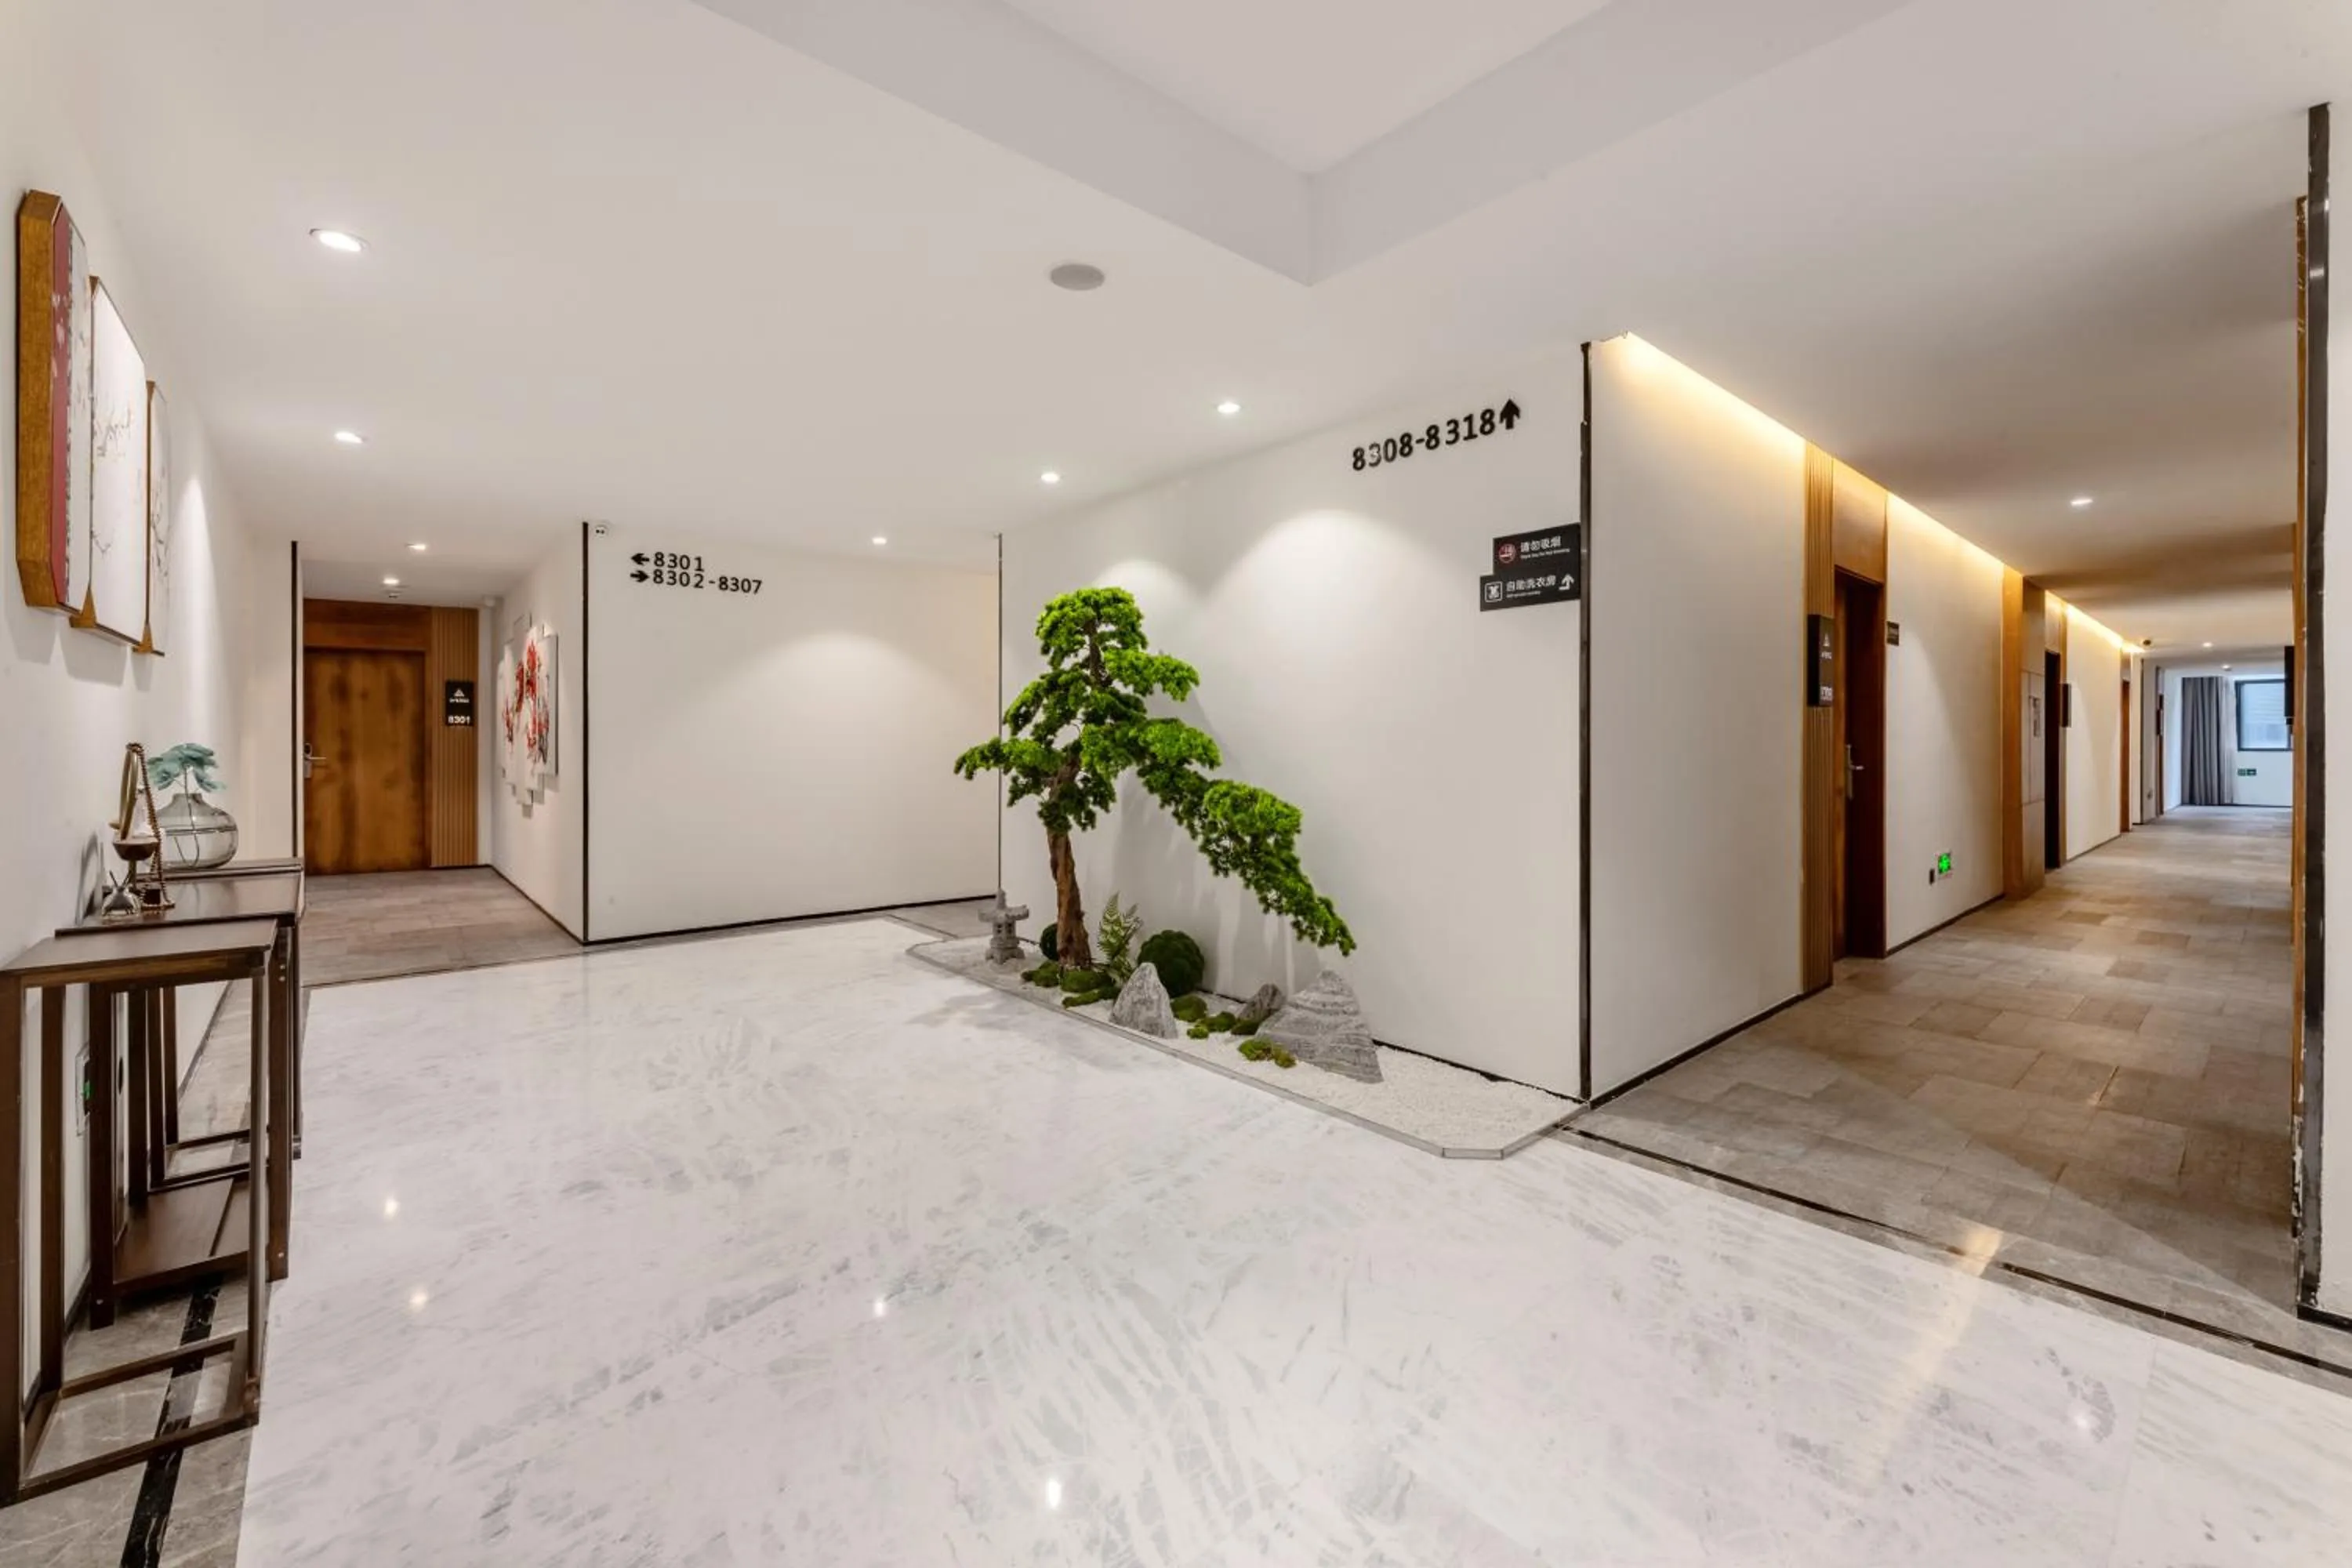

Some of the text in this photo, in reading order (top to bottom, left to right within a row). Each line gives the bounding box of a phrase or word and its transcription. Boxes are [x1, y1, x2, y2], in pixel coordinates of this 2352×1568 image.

[1352, 408, 1495, 471] 8308-8318
[653, 551, 705, 572] 8301
[652, 568, 763, 594] 8302-8307
